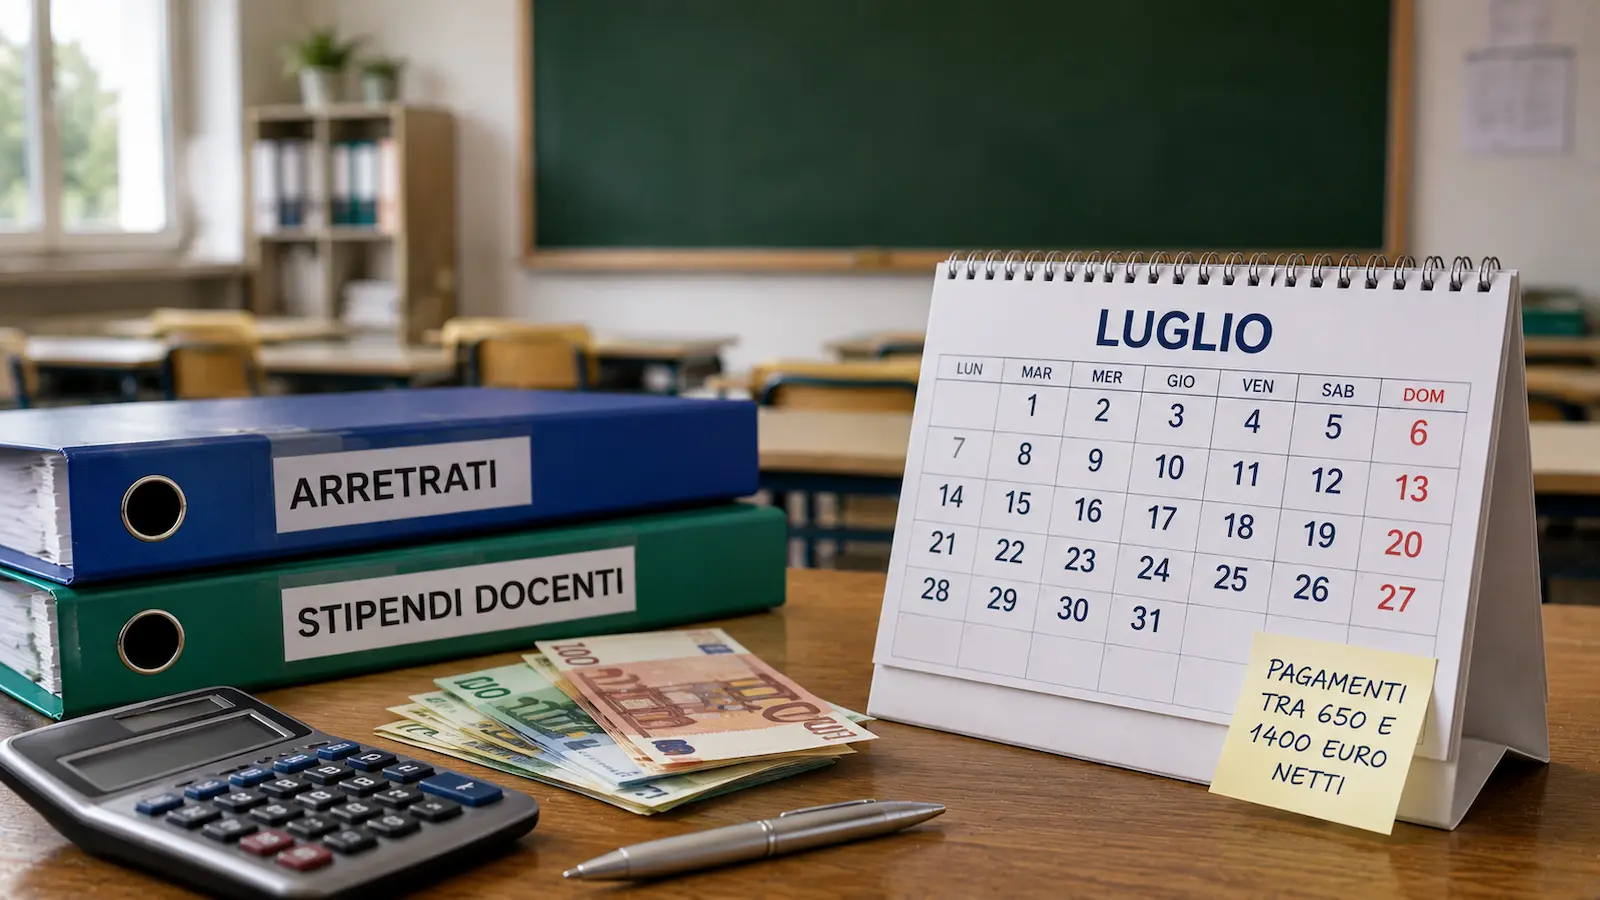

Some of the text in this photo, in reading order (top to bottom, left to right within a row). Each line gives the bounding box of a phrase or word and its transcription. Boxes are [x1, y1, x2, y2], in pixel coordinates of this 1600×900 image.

[1096, 308, 1273, 354] LUGLIO
[956, 362, 1445, 404] LUN MAR MER GIO VEN SAB DOM
[1027, 393, 1428, 446] 1 2 3 4 5 6
[289, 459, 497, 510] ARRETRATI
[953, 436, 1429, 503] 7 8 9 10 11 12 13
[939, 483, 1423, 558] 14 15 16 17 18 19 20
[929, 530, 1416, 613] 21 22 23 24 25 26 27
[298, 567, 623, 637] STIPENDI DOCENTI
[921, 577, 1161, 633] 28 29 30 31
[1266, 658, 1407, 704] PAGAMENTI
[1262, 692, 1396, 735] TRA 650 E
[1250, 723, 1387, 768] 1400 EURO
[1271, 762, 1345, 795] NETTI
